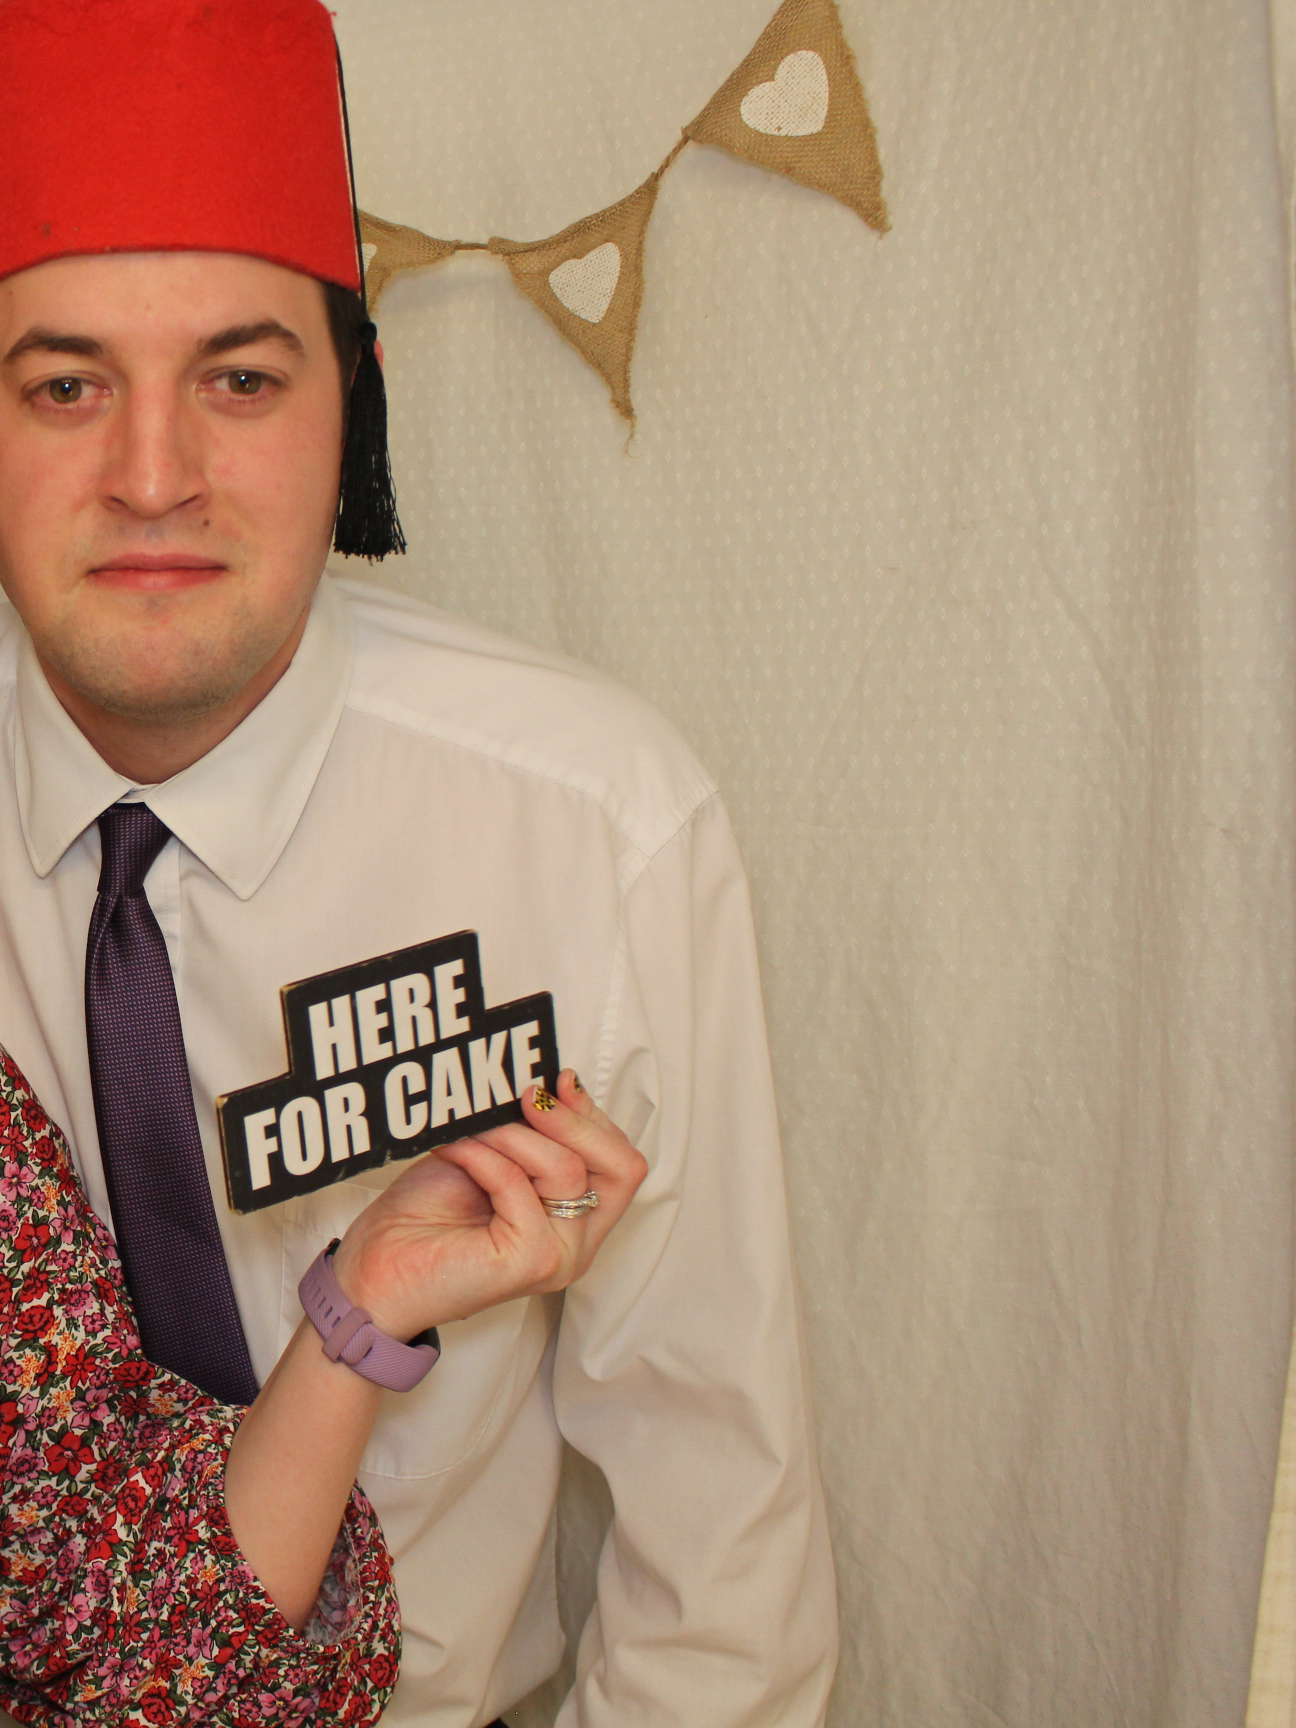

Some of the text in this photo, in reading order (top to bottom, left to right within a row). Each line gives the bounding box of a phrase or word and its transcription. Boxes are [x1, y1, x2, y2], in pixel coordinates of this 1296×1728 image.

[308, 959, 470, 1081] HERE
[244, 1020, 544, 1191] FOR CAKE
